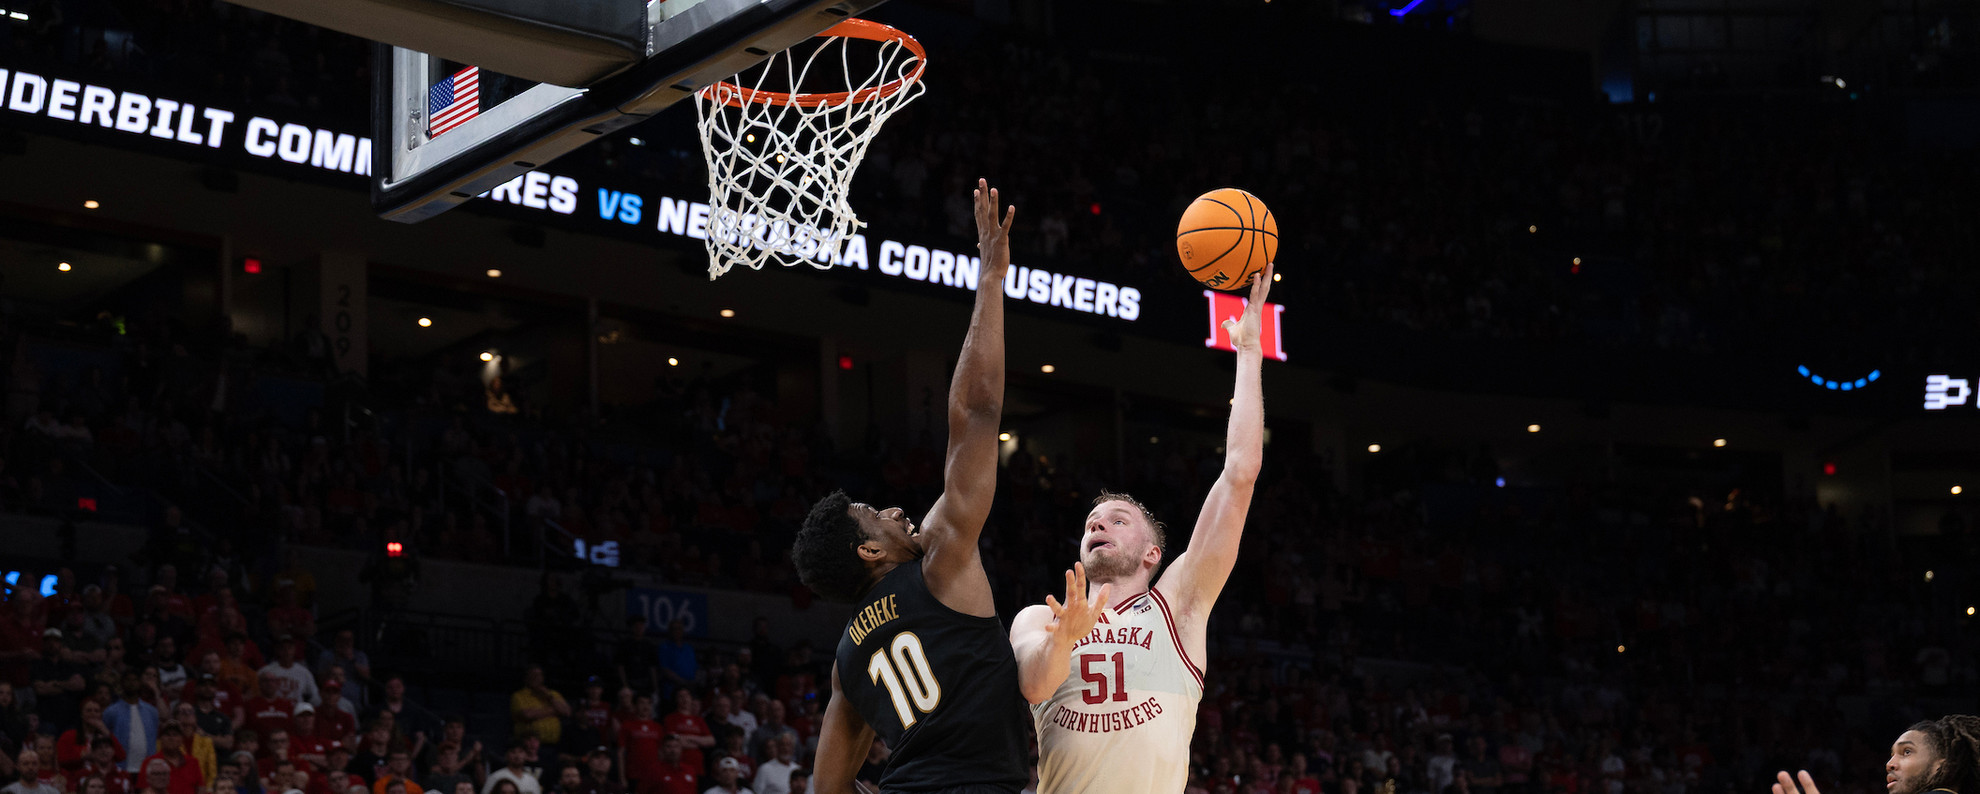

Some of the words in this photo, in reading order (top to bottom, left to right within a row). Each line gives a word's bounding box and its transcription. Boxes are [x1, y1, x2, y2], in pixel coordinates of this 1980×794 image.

[0, 68, 235, 148] DERBILT
[598, 188, 643, 225] VS
[878, 239, 1141, 321] CORNUSKERS
[638, 594, 696, 632] 106
[848, 594, 900, 646] OKEREKE
[868, 631, 941, 730] 10
[1080, 652, 1128, 705] 51
[1053, 697, 1163, 733] CORNHUSKERS
